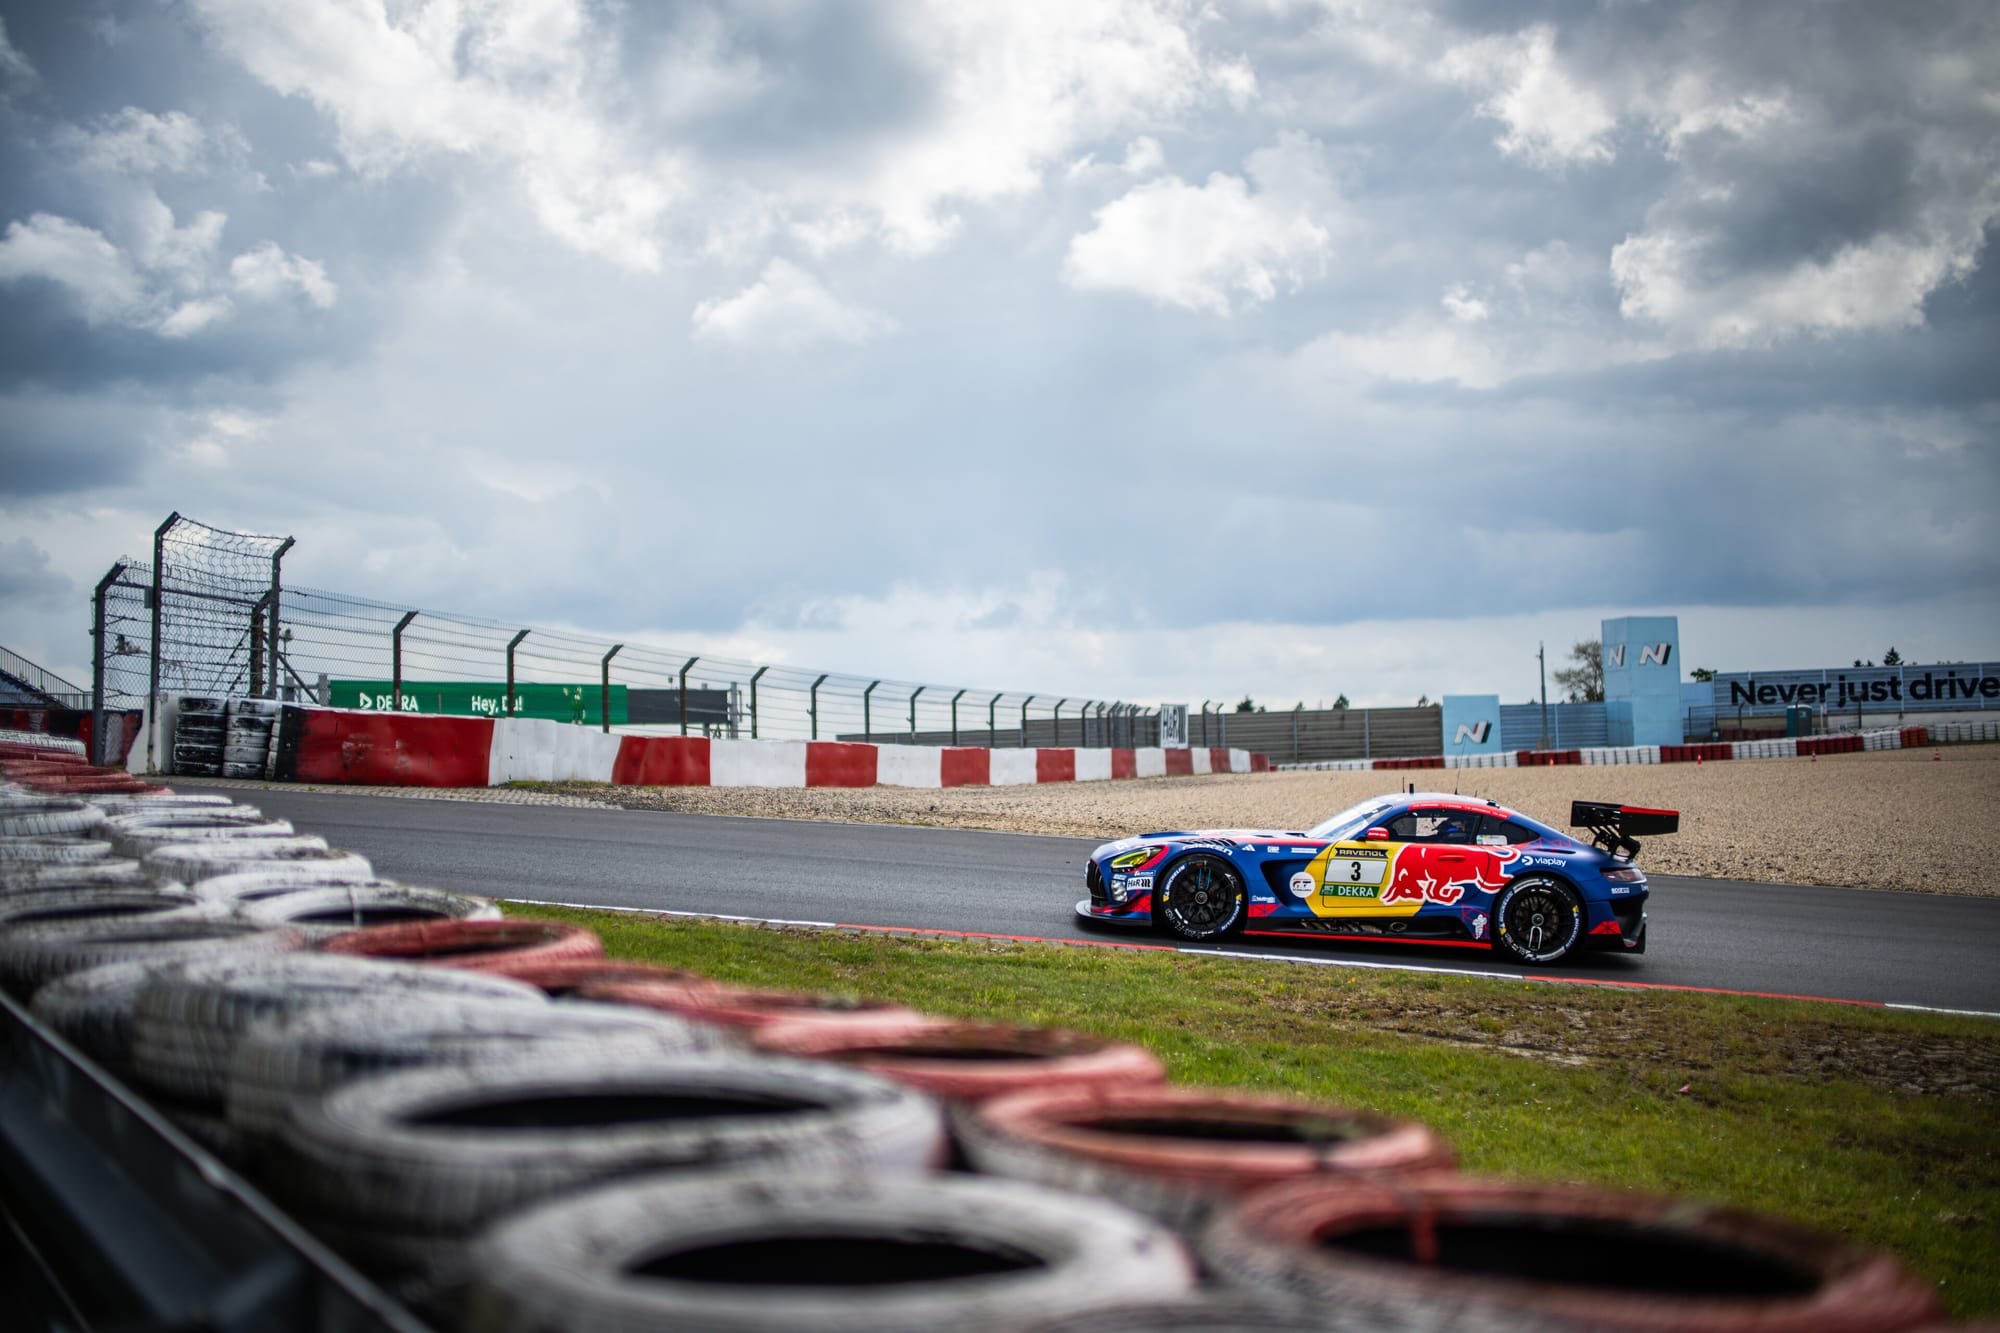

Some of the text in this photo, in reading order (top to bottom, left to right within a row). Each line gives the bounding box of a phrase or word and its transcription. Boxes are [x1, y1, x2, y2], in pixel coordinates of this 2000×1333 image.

[1731, 671, 2000, 708] Never just drive
[376, 694, 419, 711] DERA
[471, 695, 499, 715] Hey,
[1534, 857, 1567, 867] viaplay
[1351, 861, 1361, 882] 3
[1337, 886, 1375, 897] DEKRA
